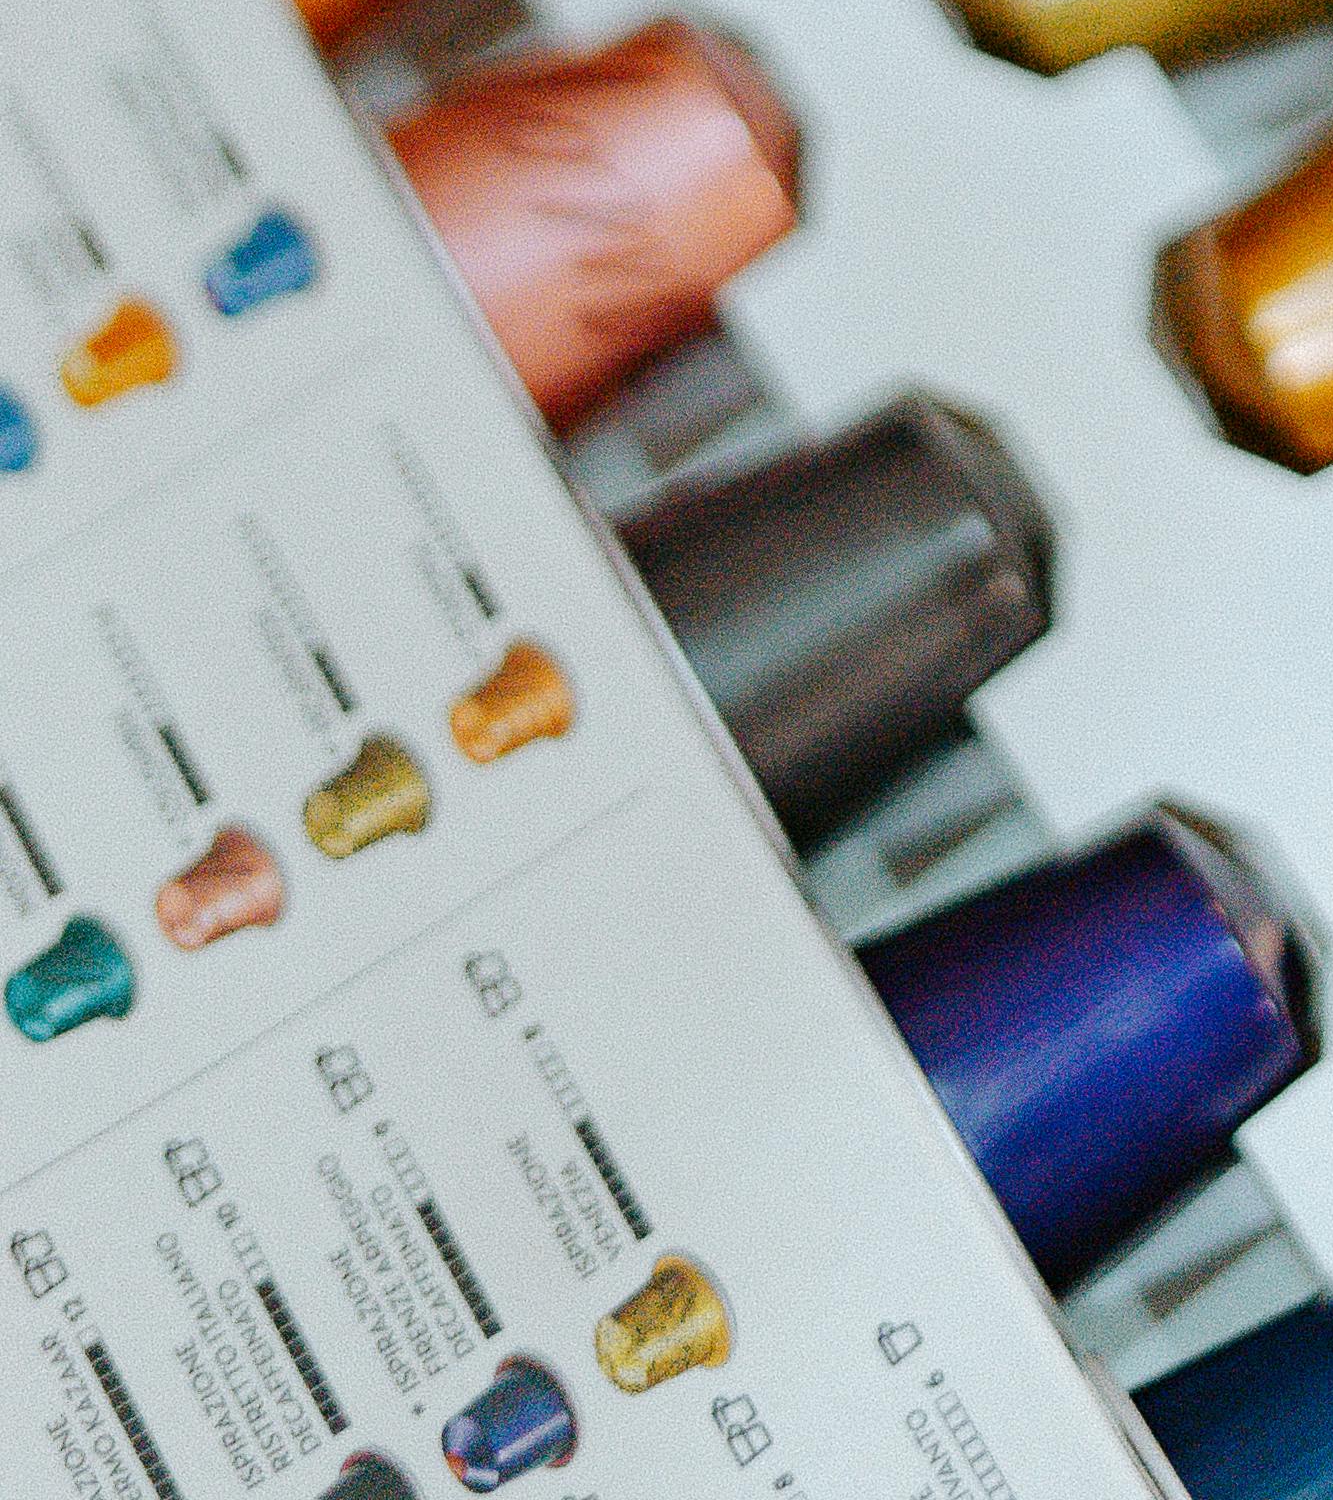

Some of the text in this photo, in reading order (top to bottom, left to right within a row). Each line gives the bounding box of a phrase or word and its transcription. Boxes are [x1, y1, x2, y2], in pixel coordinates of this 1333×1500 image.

[215, 1202, 241, 1231] 10
[315, 1153, 448, 1378] FIRENZE ARPEGGIO
[370, 1185, 476, 1360] DECAFFEINATO
[505, 1131, 599, 1281] ISPIRAZIONE
[560, 1160, 622, 1263] VENEZIA
[39, 1331, 102, 1433] KAZAAR
[62, 1295, 88, 1325] 12
[153, 1232, 293, 1474] RISTRETTO ITALIANO
[216, 1279, 322, 1457] DECAFFEINATO
[327, 1246, 421, 1396] ISPIRAZIONE
[924, 1370, 945, 1390] 6
[173, 1339, 266, 1492] ISPIRAZIONE
